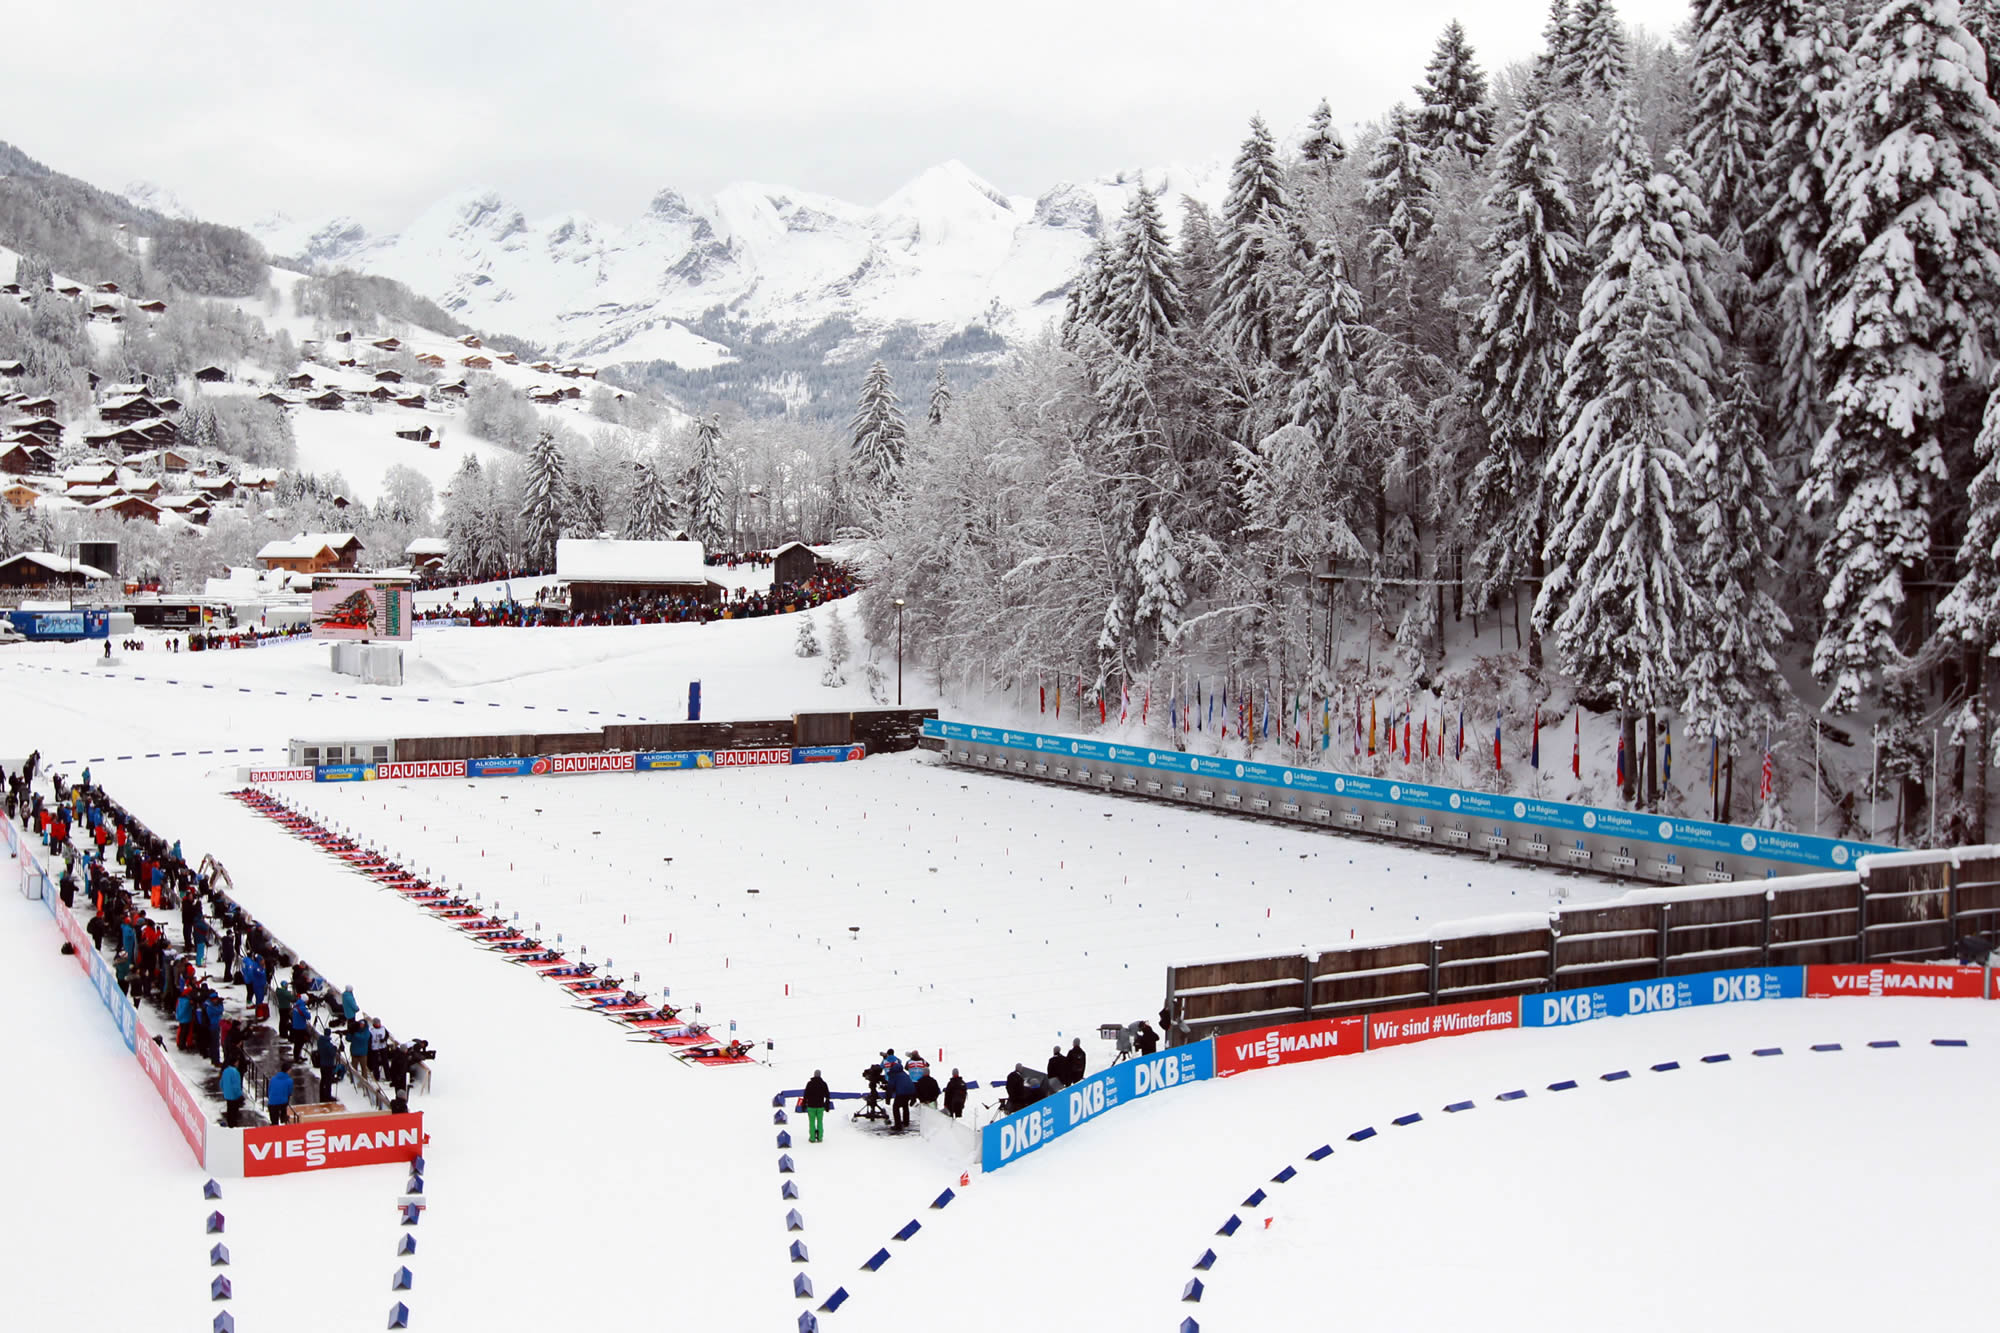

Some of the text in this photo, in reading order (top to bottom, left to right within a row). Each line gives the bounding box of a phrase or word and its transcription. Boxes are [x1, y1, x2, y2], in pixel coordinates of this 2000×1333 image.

[554, 756, 632, 771] BAUHAUS
[716, 750, 789, 764] BAUHAUS
[252, 770, 312, 782] BAUHAUS
[379, 763, 464, 778] BAUHAUS
[1253, 767, 1267, 775] Région
[1300, 774, 1317, 782] Région
[1353, 781, 1371, 790] Région
[1402, 787, 1429, 798] La Région
[1462, 795, 1491, 806] La Région
[1528, 804, 1559, 817] La Région
[1598, 814, 1632, 827] La Région
[1675, 824, 1712, 837] La Région
[1759, 836, 1799, 849] La Région
[1713, 974, 1761, 1002] DKB
[1832, 969, 1954, 997] VIESSMANN
[1629, 983, 1675, 1014] DKB
[1543, 993, 1592, 1025] DKB
[1373, 1021, 1399, 1040] Wir
[1402, 1018, 1429, 1036] sind
[1433, 1009, 1513, 1032] #Winterfans
[1235, 1031, 1338, 1065] VIESSMANN
[1182, 1053, 1192, 1062] Das
[1182, 1063, 1195, 1073] kann
[1106, 1076, 1115, 1086] Das
[1135, 1056, 1179, 1095] DKB
[1182, 1073, 1195, 1082] Bank
[1106, 1086, 1117, 1097] kann
[1070, 1080, 1104, 1126] DKB
[1043, 1106, 1052, 1116] Das
[1043, 1117, 1054, 1127] kann
[1001, 1110, 1042, 1160] DKB
[248, 1127, 418, 1167] VIESSMANN
